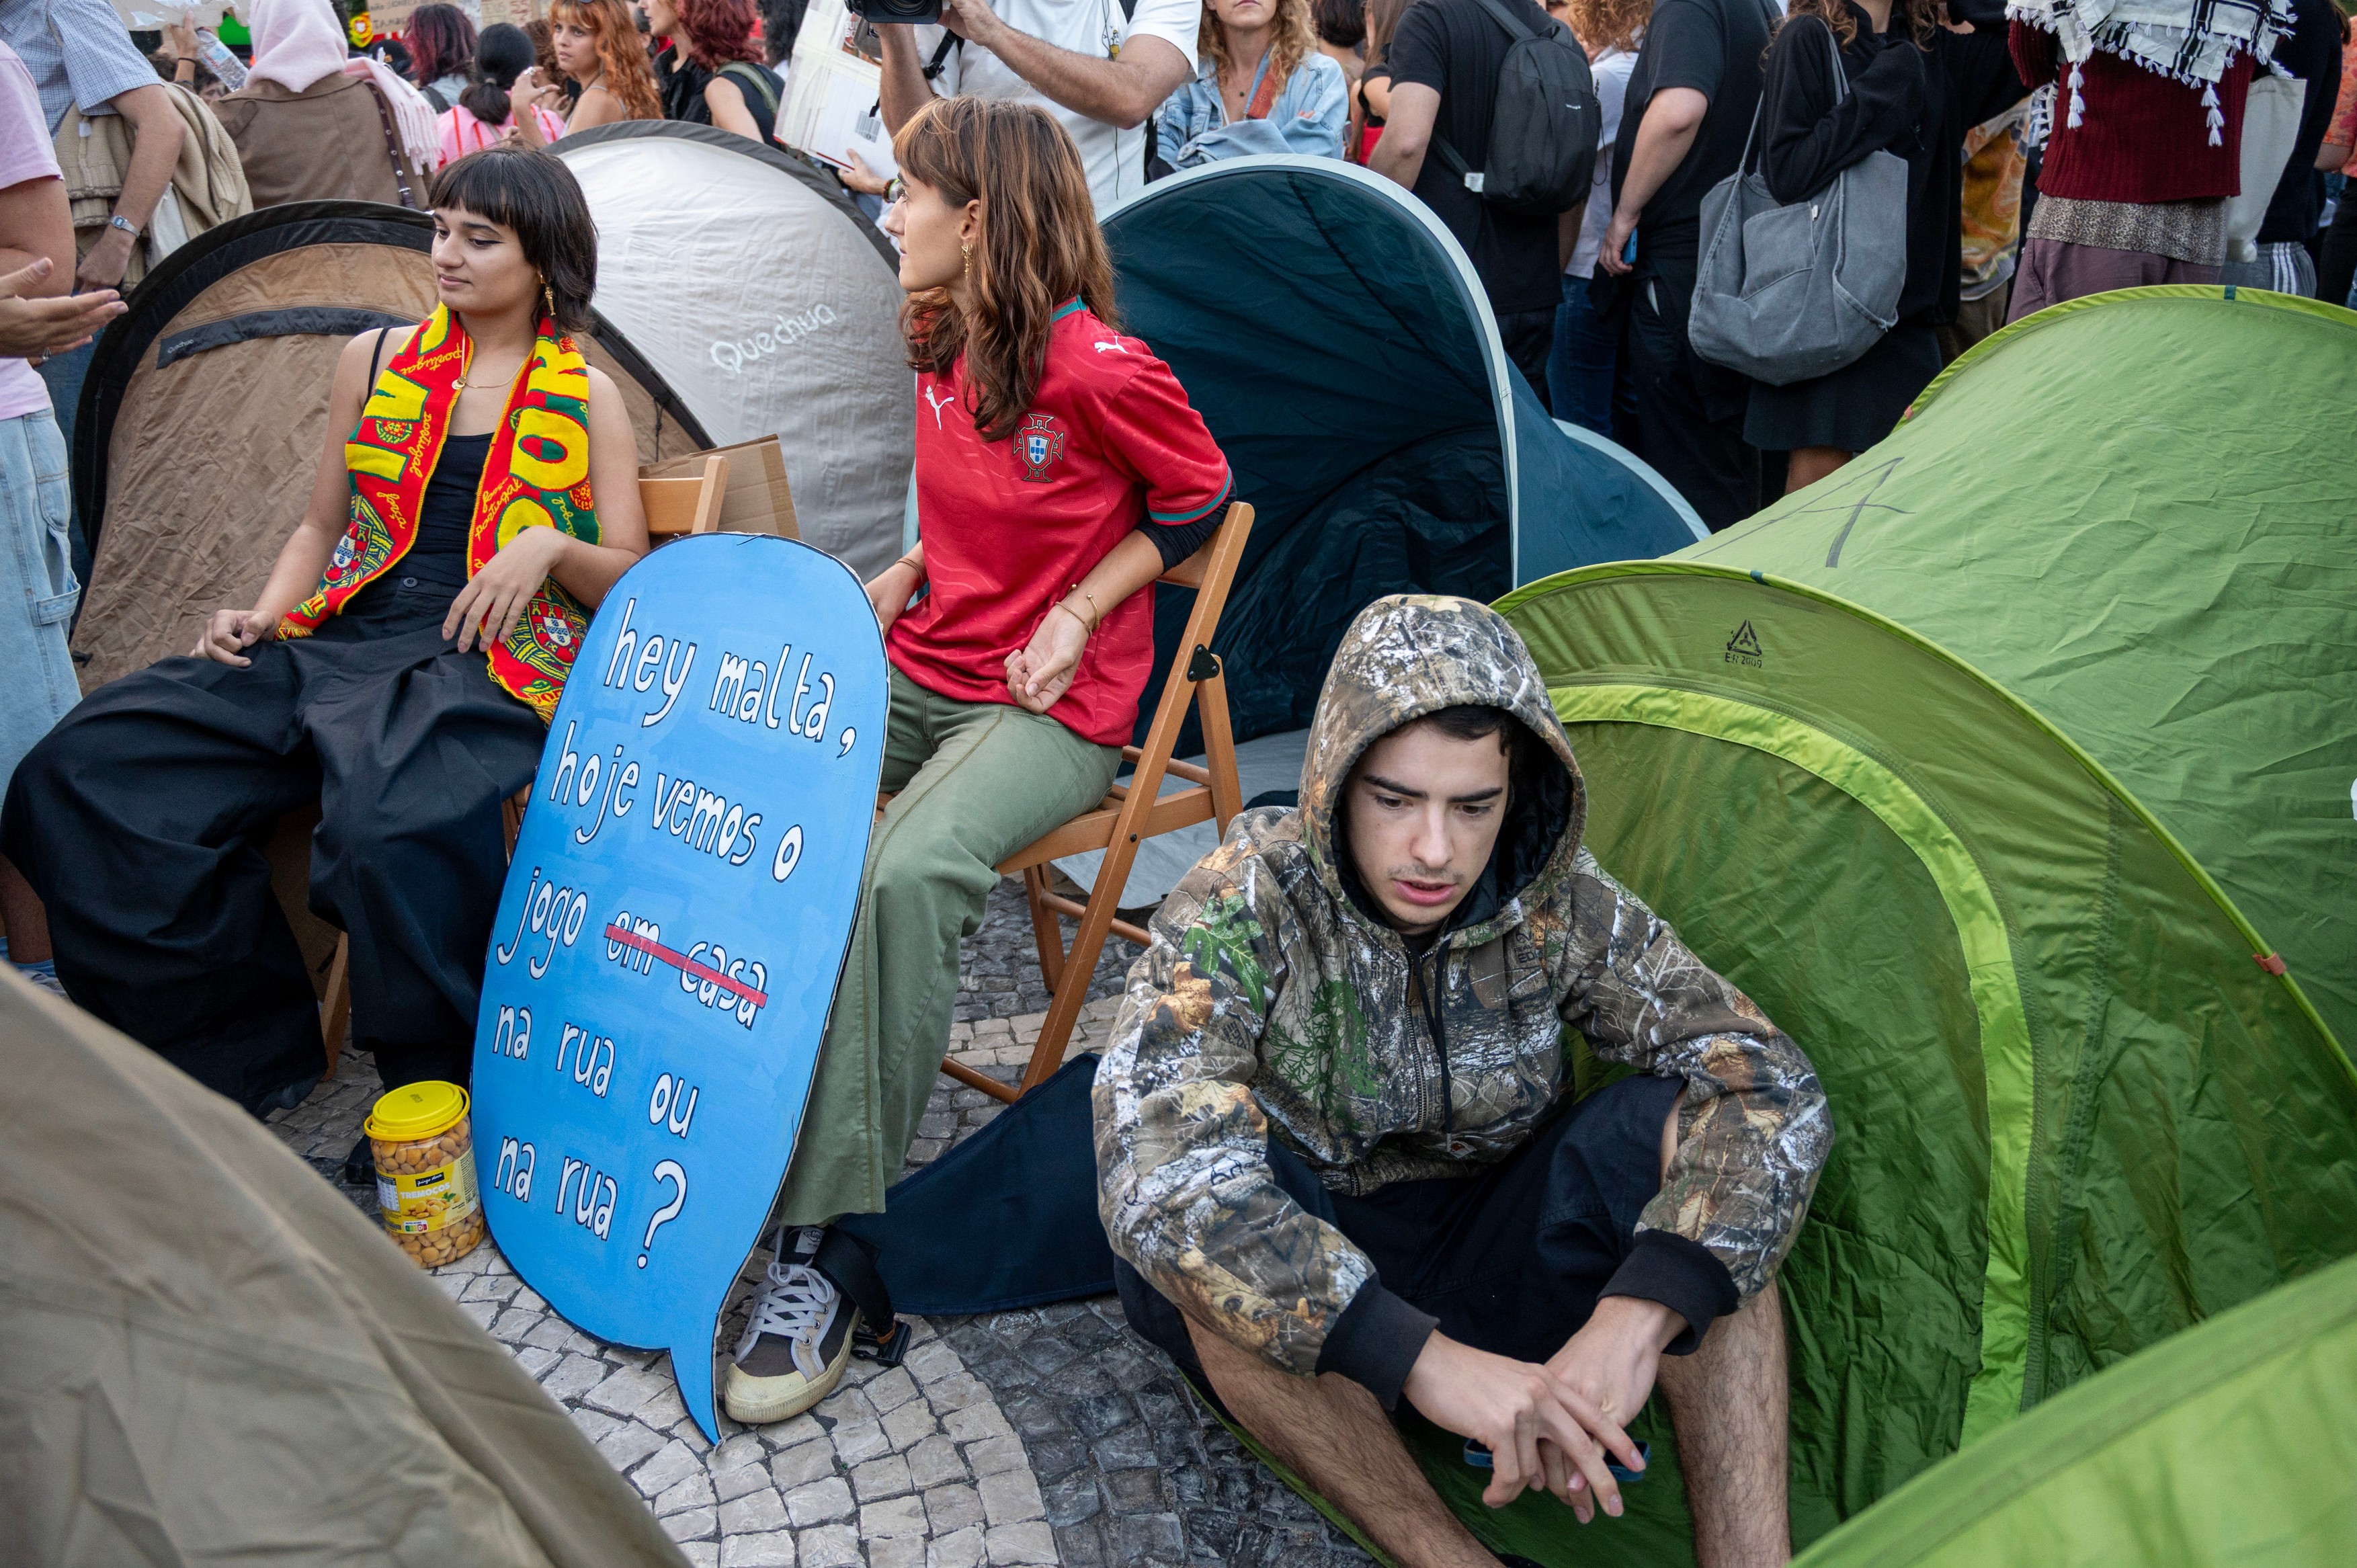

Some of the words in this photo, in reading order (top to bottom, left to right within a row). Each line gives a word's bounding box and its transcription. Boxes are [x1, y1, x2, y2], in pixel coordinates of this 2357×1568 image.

[710, 304, 837, 374] Quechua
[604, 597, 697, 728] hey
[549, 720, 640, 845] hoje
[652, 772, 763, 866] vemos
[772, 824, 804, 883] o
[497, 866, 588, 980] jogo
[679, 941, 768, 1031] casa
[493, 1004, 532, 1061] na
[555, 1022, 616, 1098] rua
[649, 1072, 700, 1139] ou
[400, 1182, 451, 1200] TREMOÇOS
[494, 1136, 536, 1203] na
[554, 1156, 618, 1241] rua
